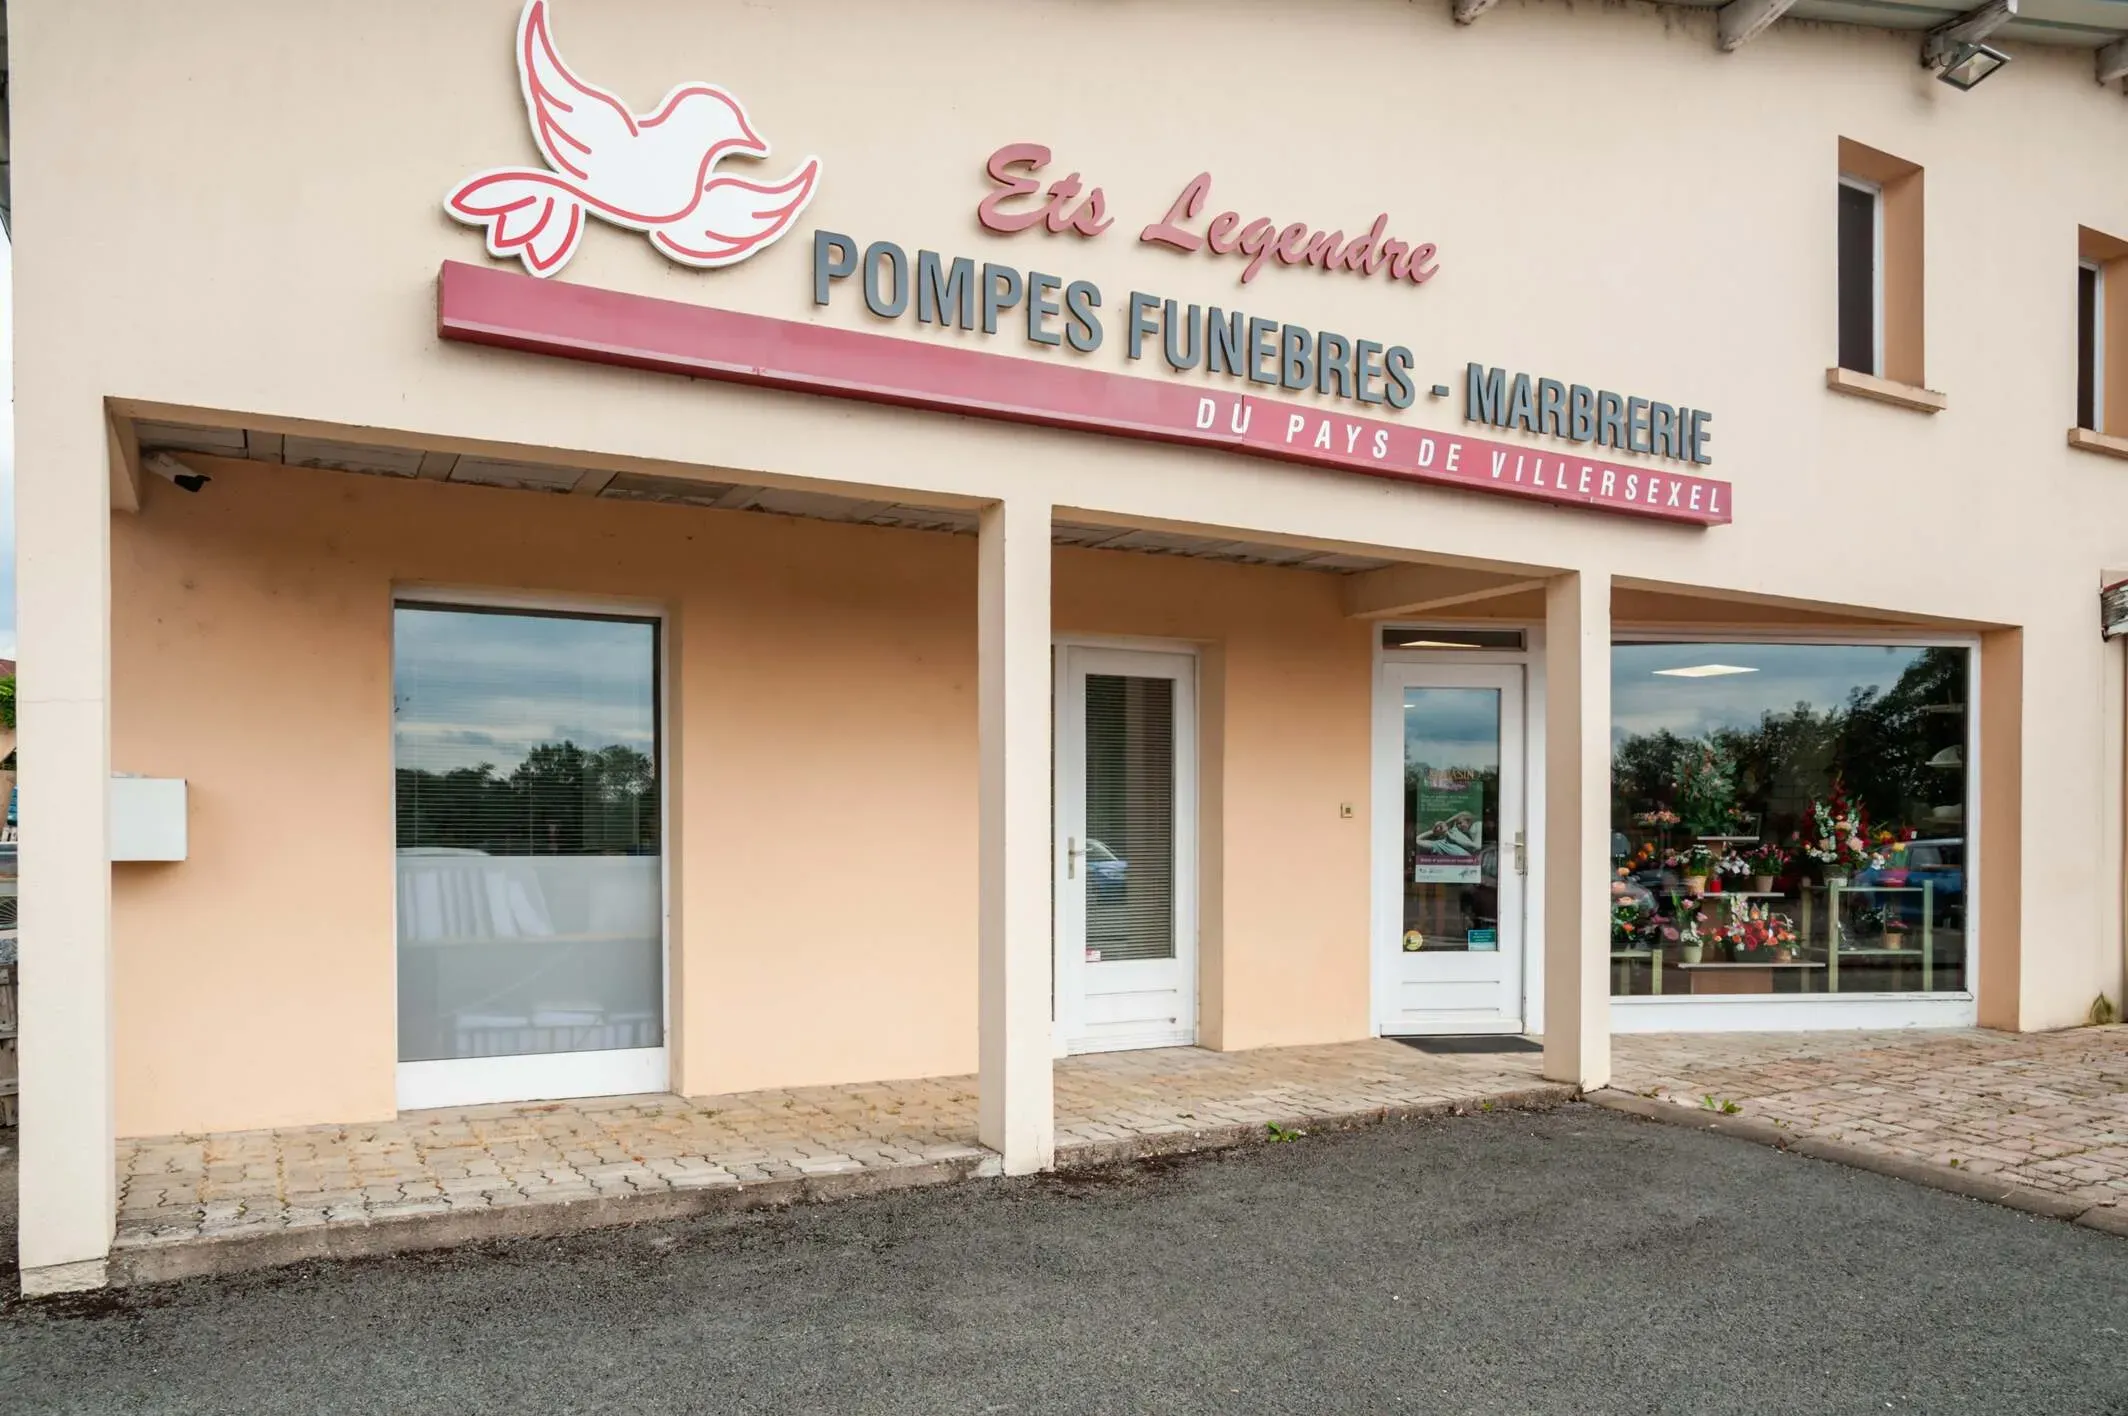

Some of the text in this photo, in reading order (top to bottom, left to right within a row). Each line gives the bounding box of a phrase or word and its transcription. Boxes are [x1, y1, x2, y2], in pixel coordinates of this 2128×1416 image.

[976, 142, 1440, 284] Ets Legendre
[813, 229, 1713, 466] POMPES FUNEBRES - MARBRERIE
[1195, 398, 1720, 513] DU PAYS DE VILLERSEXEL
